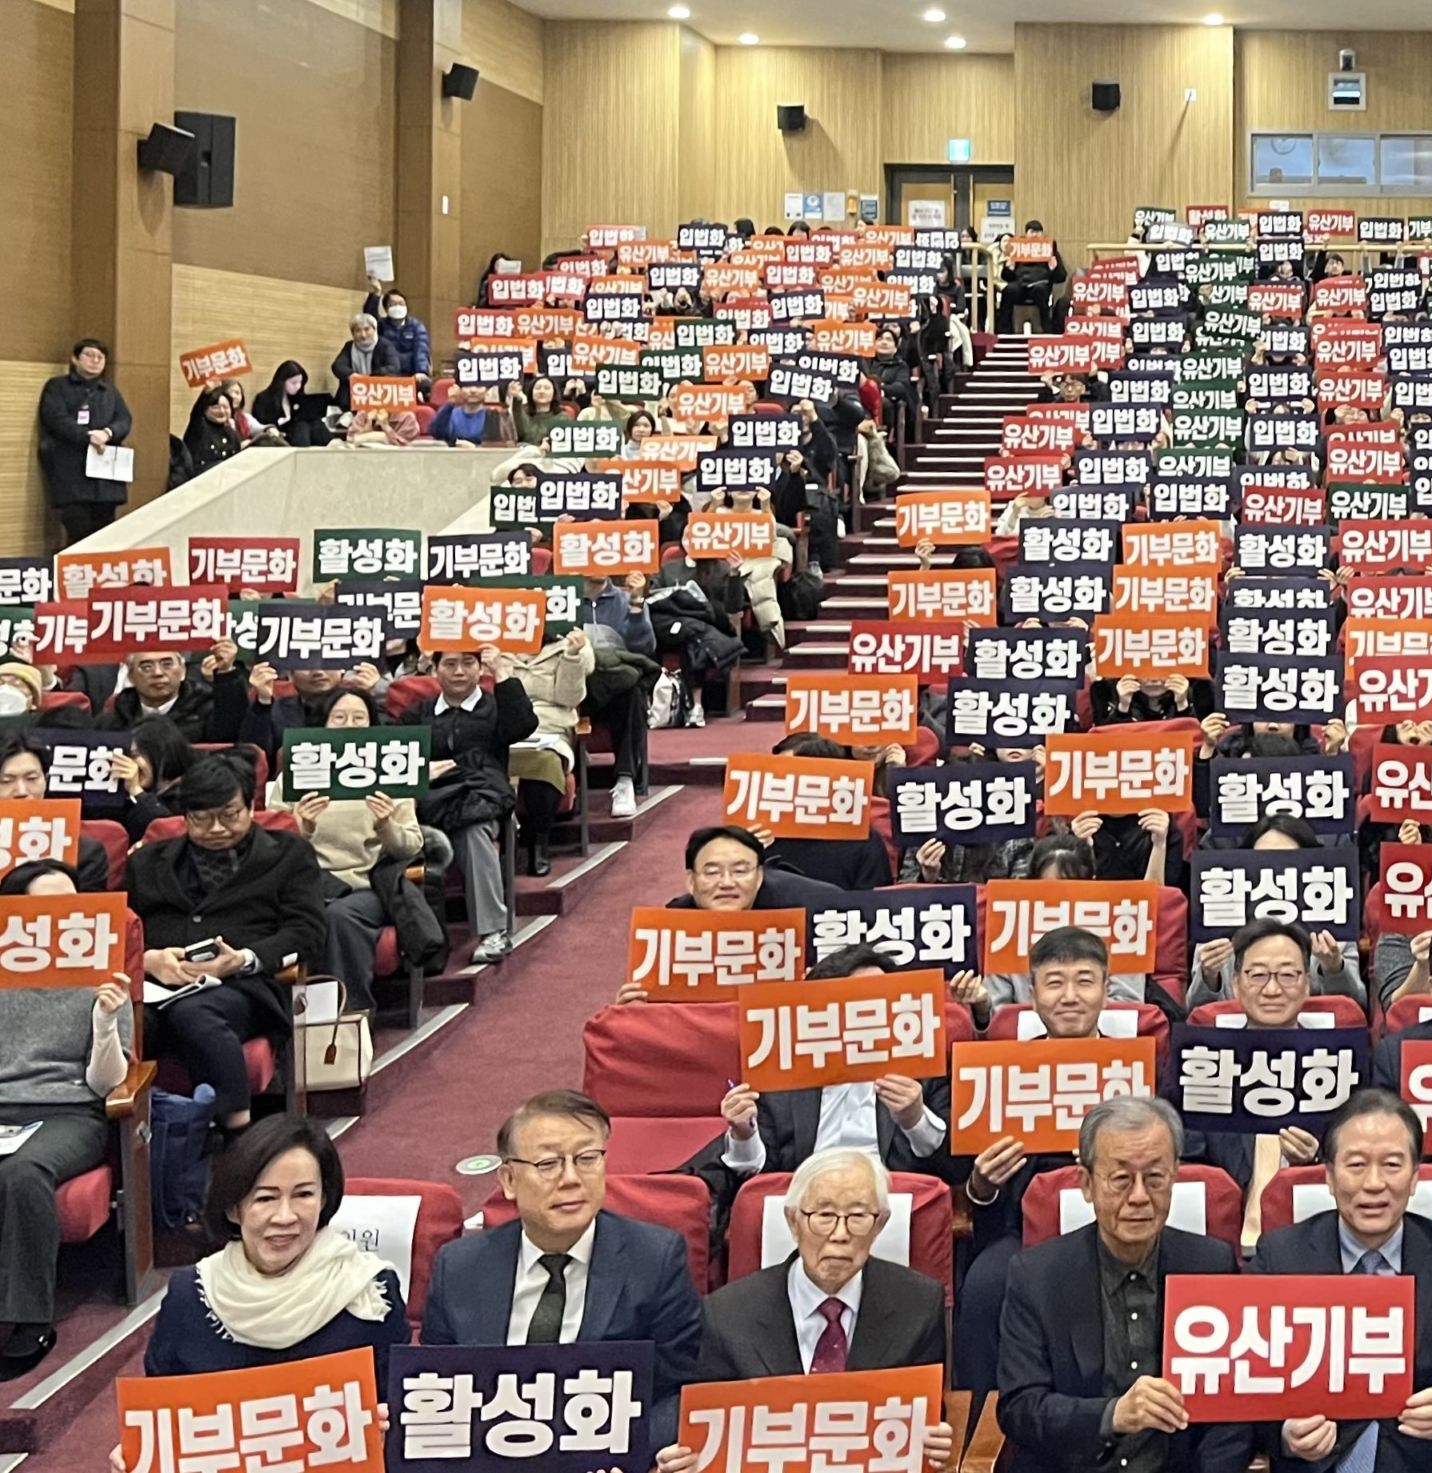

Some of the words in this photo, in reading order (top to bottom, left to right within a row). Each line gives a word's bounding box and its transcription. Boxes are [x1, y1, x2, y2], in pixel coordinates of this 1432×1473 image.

[771, 294, 822, 318] 입법화
[1132, 288, 1178, 308] 입법화
[459, 315, 513, 335] 입법화
[677, 325, 734, 344] 입법화
[817, 331, 874, 350] 유산기부
[184, 345, 249, 380] 기부문화
[458, 358, 520, 381] 입법화
[1030, 346, 1090, 366] 유산기부
[1184, 356, 1242, 379] 유산기부
[352, 384, 415, 406] 유산기부
[599, 369, 661, 394] 입법화
[770, 371, 832, 401] 입법화
[1250, 375, 1310, 396] 입법화
[1319, 379, 1382, 401] 유산기부
[679, 393, 744, 415] 유산기부
[733, 421, 801, 446] 입법화
[1005, 424, 1073, 449] 유산기부
[1093, 408, 1159, 435] 입법화
[1175, 416, 1242, 441] 유산기부
[1254, 421, 1318, 445] 입법화
[551, 426, 619, 452] 입법화
[701, 458, 773, 484] 입법화
[987, 465, 1060, 490] 유산기부
[1079, 457, 1149, 484] 입법화
[1330, 450, 1401, 477] 유산기부
[541, 482, 619, 510] 입법화
[1155, 484, 1229, 512] 입법화
[1245, 494, 1322, 524] 유산기부
[1331, 491, 1407, 519] 유산기부
[900, 502, 988, 534] 기부문화
[559, 533, 654, 567] 활성화
[692, 523, 770, 549] 유산기부
[1023, 528, 1112, 562] 활성화
[1126, 532, 1218, 565] 기부문화
[1239, 534, 1326, 567] 활성화
[1342, 531, 1432, 561] 유산기부
[191, 548, 295, 584] 기부문화
[319, 537, 418, 576] 활성화
[430, 543, 529, 578] 기부문화
[893, 582, 993, 616] 기부문화
[1010, 575, 1106, 612] 활성화
[1116, 578, 1214, 612] 기부문화
[92, 593, 223, 639] 기부문화
[428, 599, 539, 641] 활성화
[260, 618, 383, 658] 기부문화
[1099, 628, 1205, 666] 기부문화
[1228, 618, 1330, 656] 활성화
[854, 636, 960, 672] 유산기부
[975, 640, 1081, 679] 활성화
[1223, 666, 1339, 712] 활성화
[795, 690, 914, 733] 기부문화
[953, 691, 1071, 737] 활성화
[289, 741, 425, 788] 활성화
[1051, 747, 1188, 799] 기부문화
[728, 768, 868, 825] 기부문화
[897, 775, 1031, 832] 활성화
[1218, 768, 1349, 822] 활성화
[1202, 867, 1353, 926] 활성화
[634, 928, 801, 986] 기부문화
[746, 993, 940, 1070] 기부문화
[1180, 1047, 1358, 1115] 활성화
[1171, 1305, 1405, 1395] 유산기부
[401, 1370, 641, 1458] 활성화
